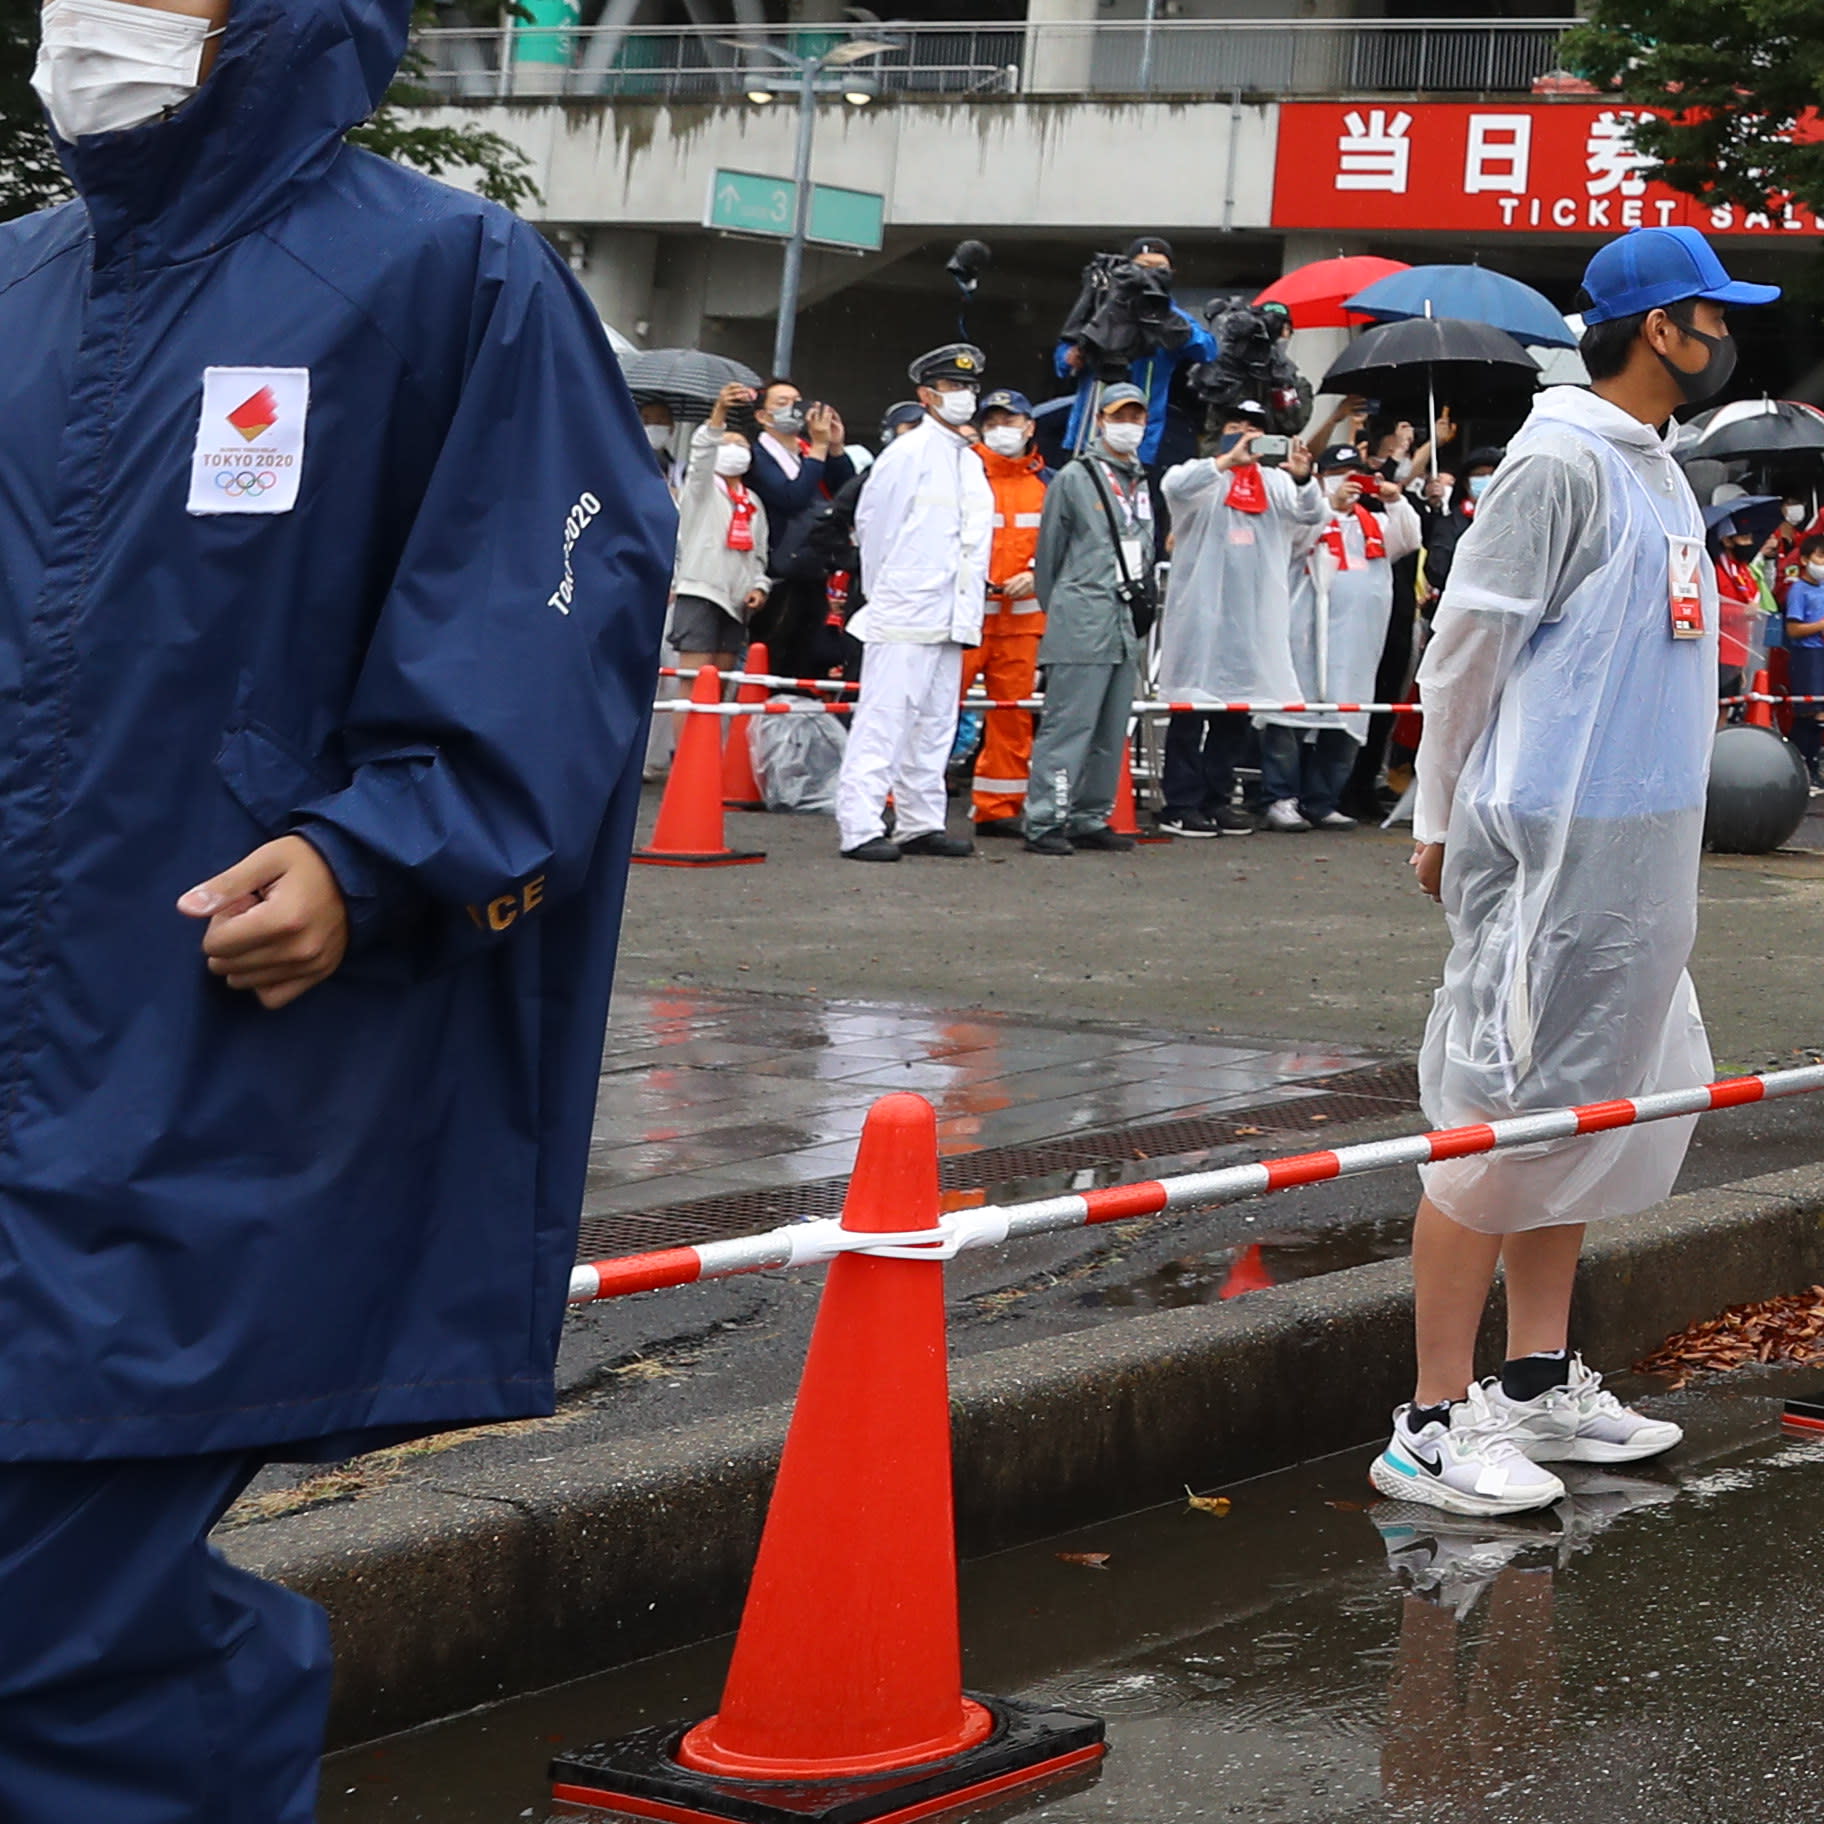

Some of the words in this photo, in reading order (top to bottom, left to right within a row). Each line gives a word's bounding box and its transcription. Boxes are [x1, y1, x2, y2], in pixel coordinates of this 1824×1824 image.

[770, 190, 787, 222] 3
[1498, 198, 1677, 226] TICKET
[203, 454, 253, 467] TOKYO
[256, 454, 294, 467] 2020
